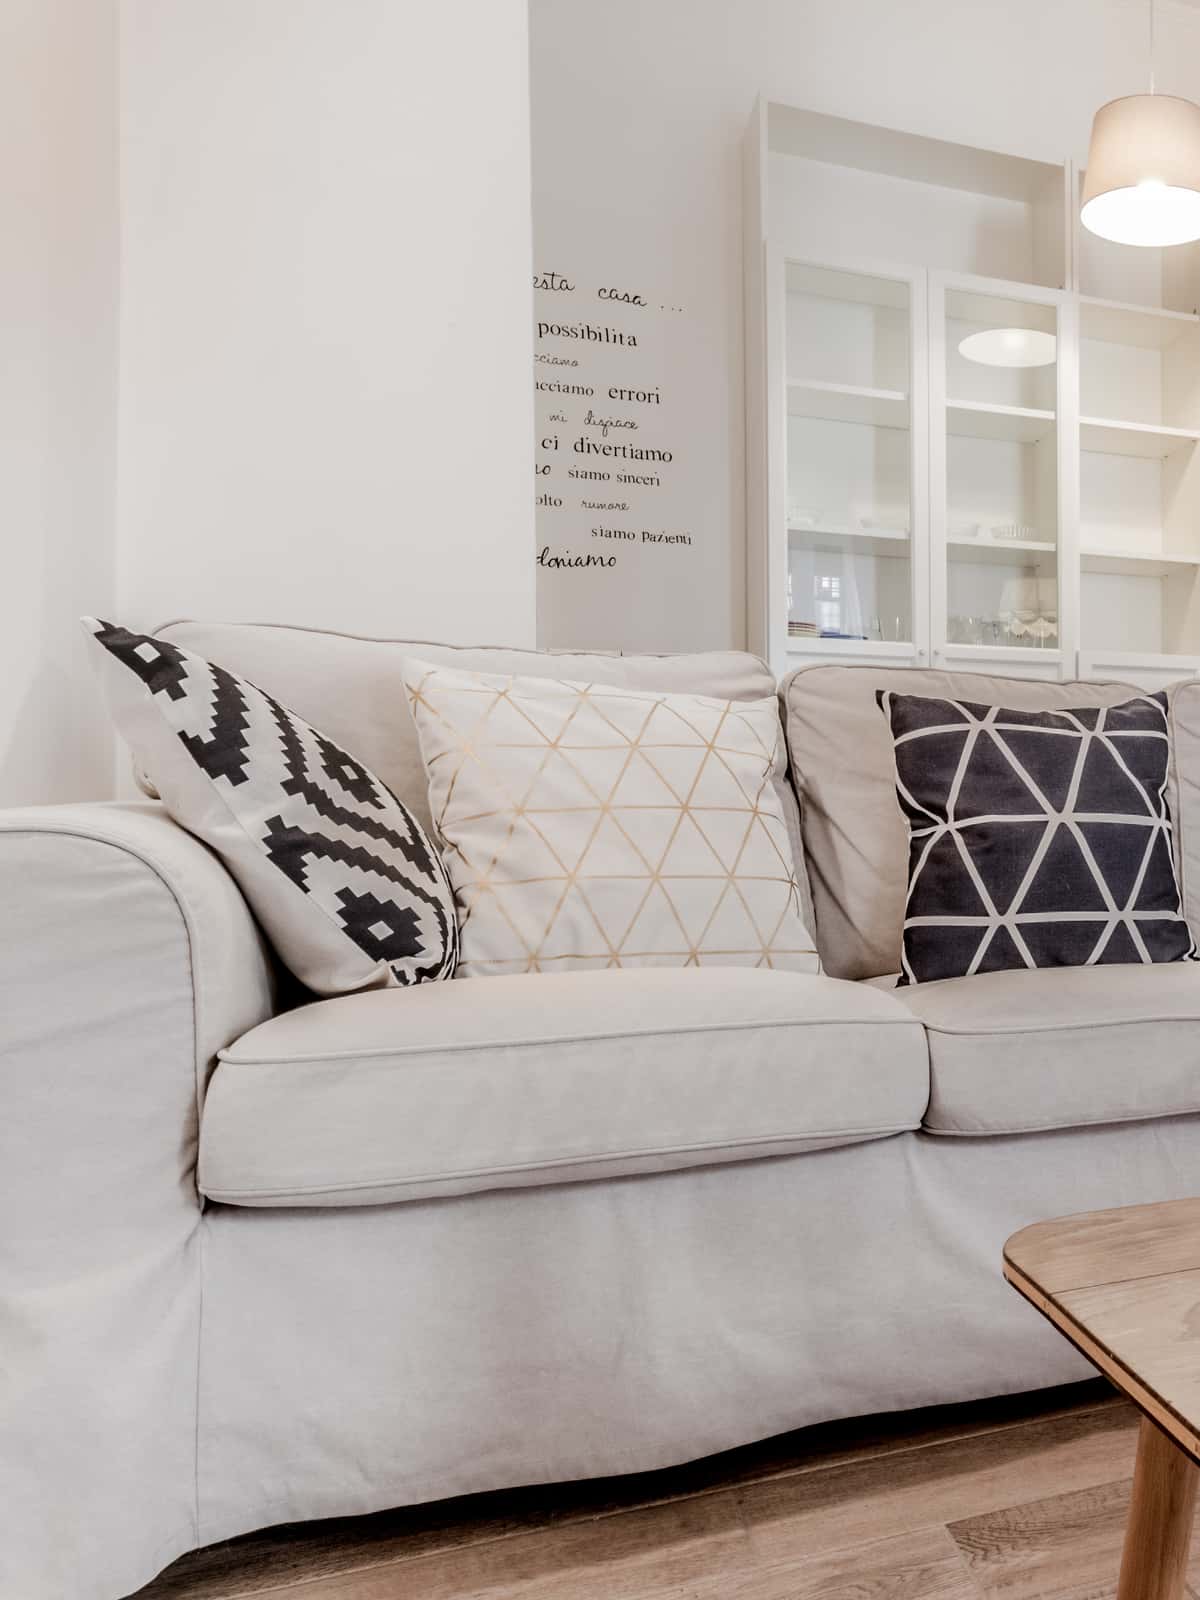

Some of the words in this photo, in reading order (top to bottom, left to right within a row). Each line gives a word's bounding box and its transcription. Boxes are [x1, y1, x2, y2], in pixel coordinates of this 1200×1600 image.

[597, 287, 648, 307] casa
[537, 322, 638, 348] possibilita
[607, 386, 660, 405] errori
[540, 435, 559, 451] ci
[572, 436, 673, 463] divertiamo
[567, 464, 611, 481] siamo
[616, 468, 661, 487] sinceri
[580, 499, 631, 512] rumore
[591, 525, 636, 541] siamo
